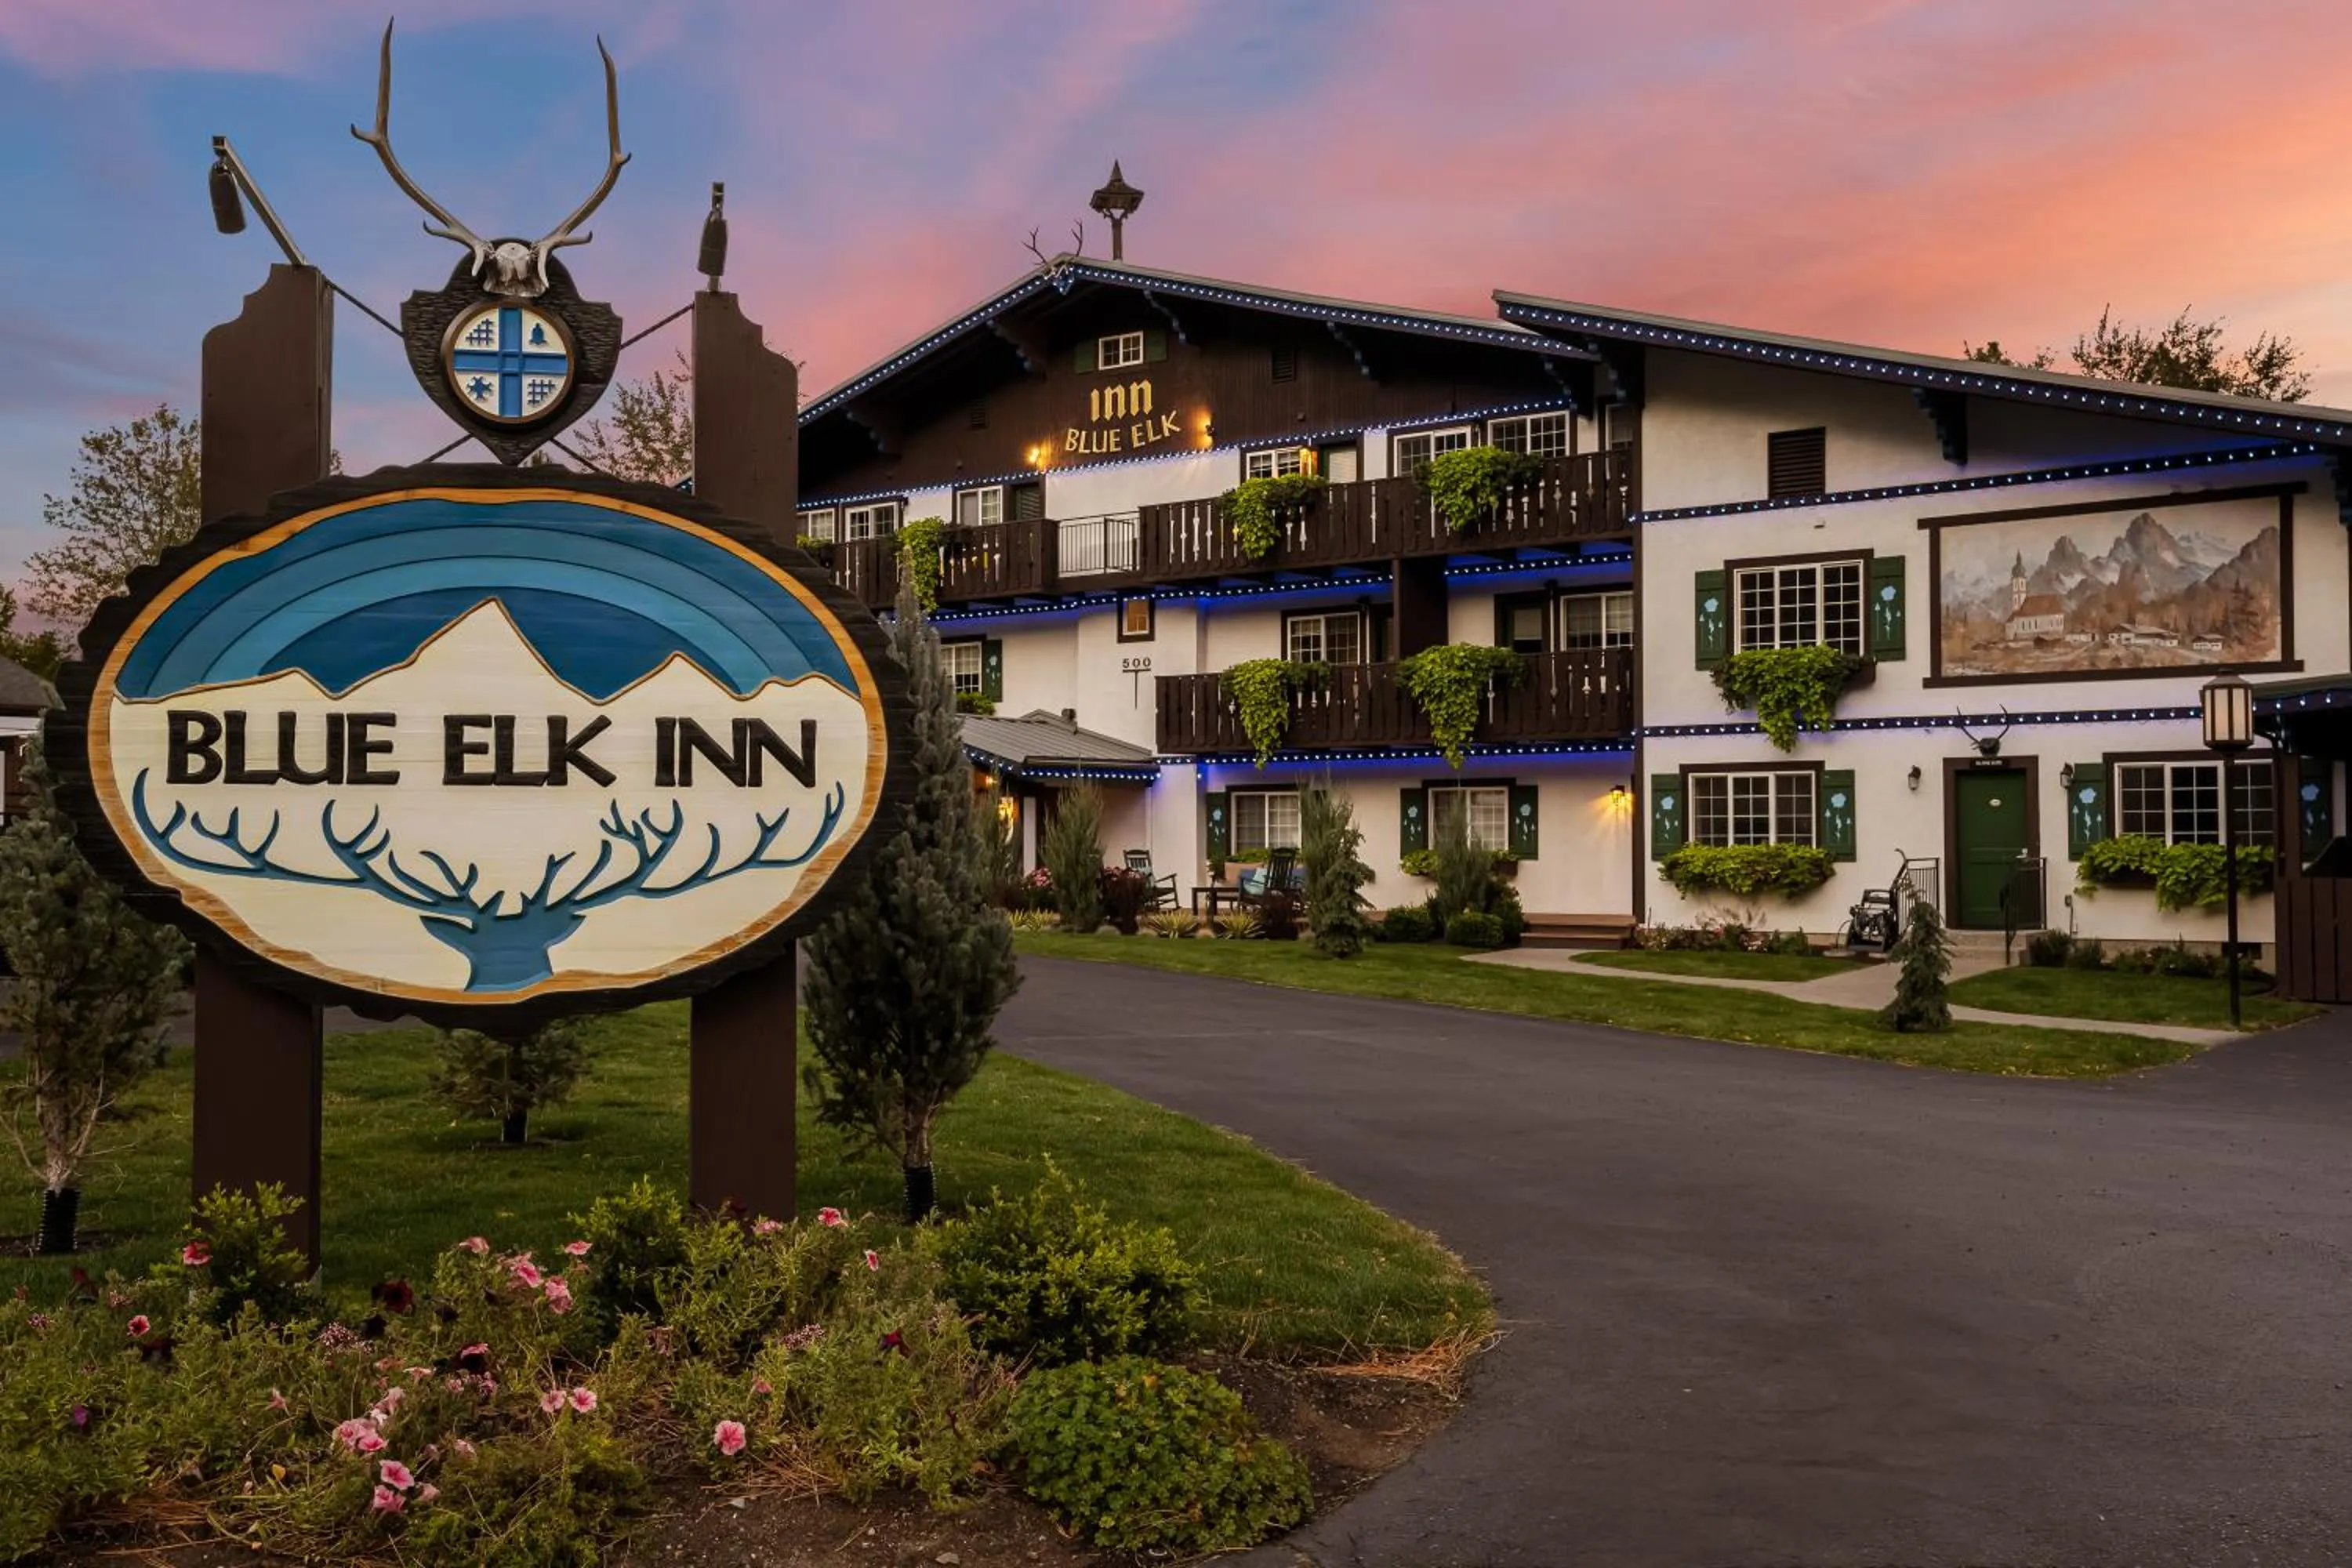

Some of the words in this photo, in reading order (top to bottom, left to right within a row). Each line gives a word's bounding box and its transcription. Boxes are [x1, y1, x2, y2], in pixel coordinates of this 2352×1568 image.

[1064, 427, 1122, 454] BLUE
[1131, 409, 1181, 448] ELK
[1122, 657, 1152, 669] 500
[166, 710, 401, 786] BLUE
[442, 714, 617, 788] ELK
[655, 717, 817, 789] INN
